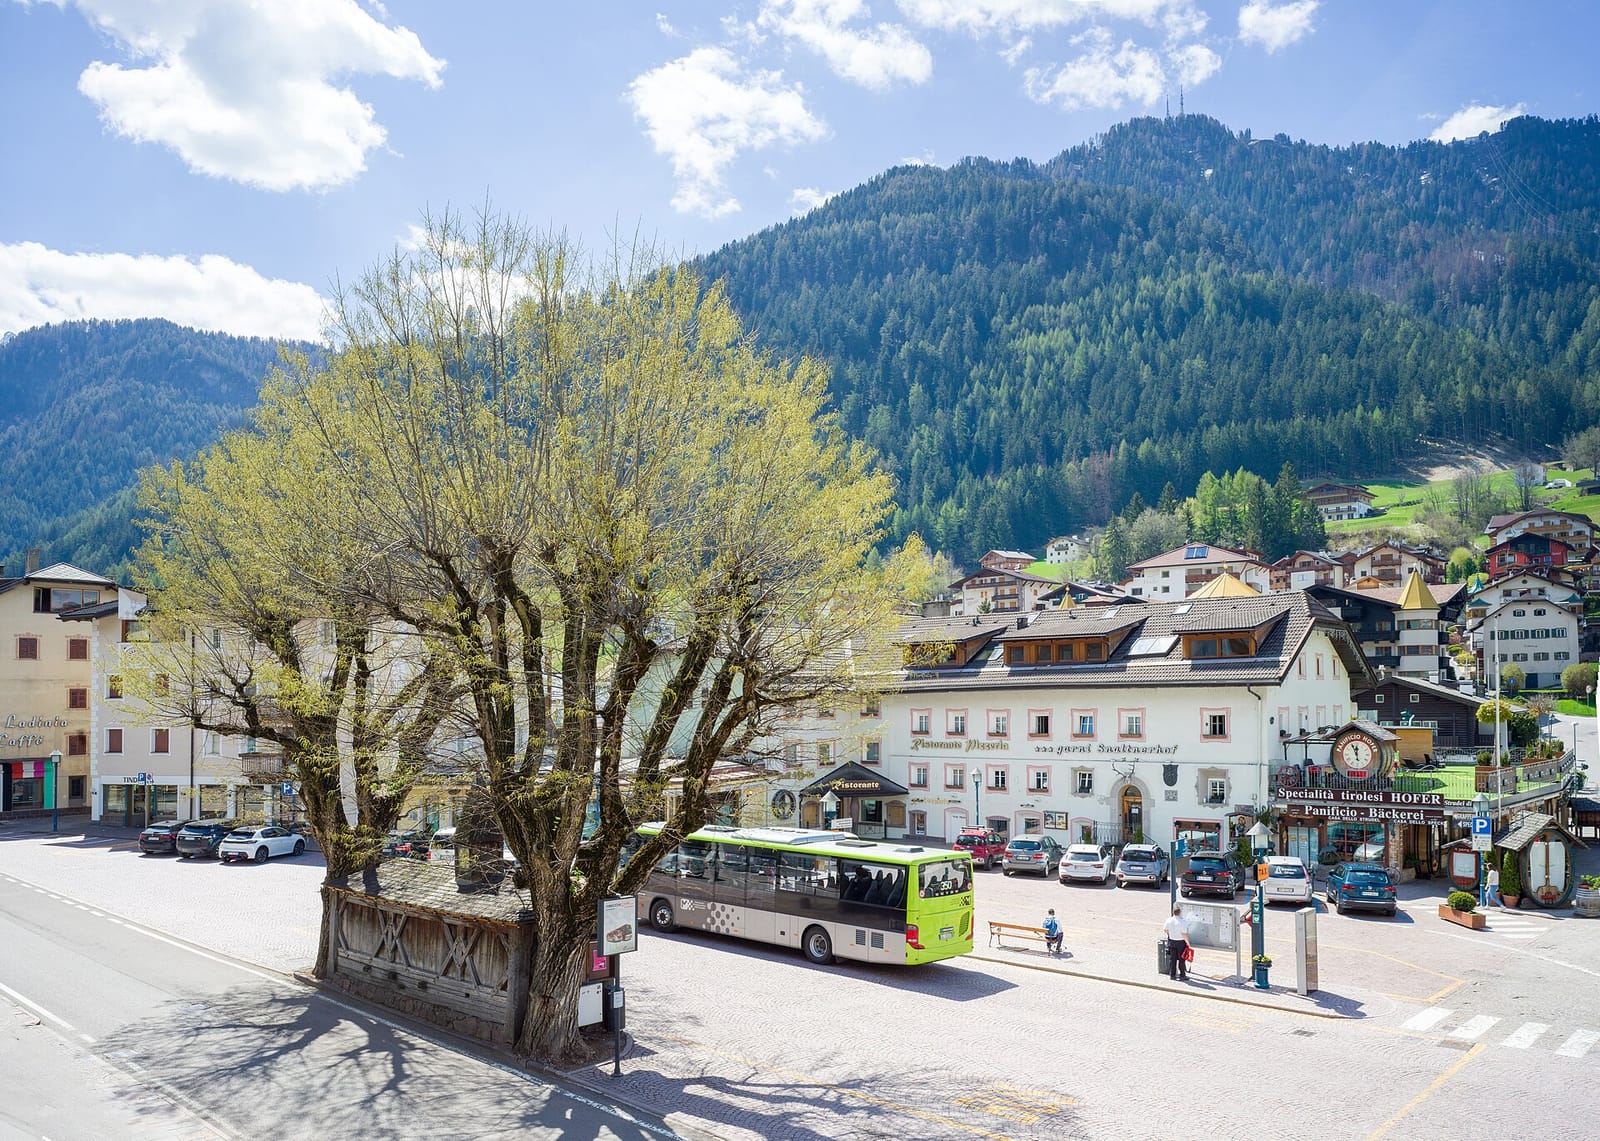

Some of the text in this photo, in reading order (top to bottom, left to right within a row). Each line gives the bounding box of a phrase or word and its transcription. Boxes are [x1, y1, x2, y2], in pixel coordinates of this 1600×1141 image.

[5, 713, 68, 728] Ladinia
[911, 738, 1009, 752] Ristorante Pizzeria
[1057, 743, 1092, 756] garni
[831, 779, 880, 791] Ristorante
[1278, 788, 1441, 805] Specialità tirolesi HOFER
[1305, 805, 1357, 817] Panificio
[1369, 808, 1424, 820] Bäckerei
[1476, 819, 1488, 833] P
[940, 881, 953, 891] 350
